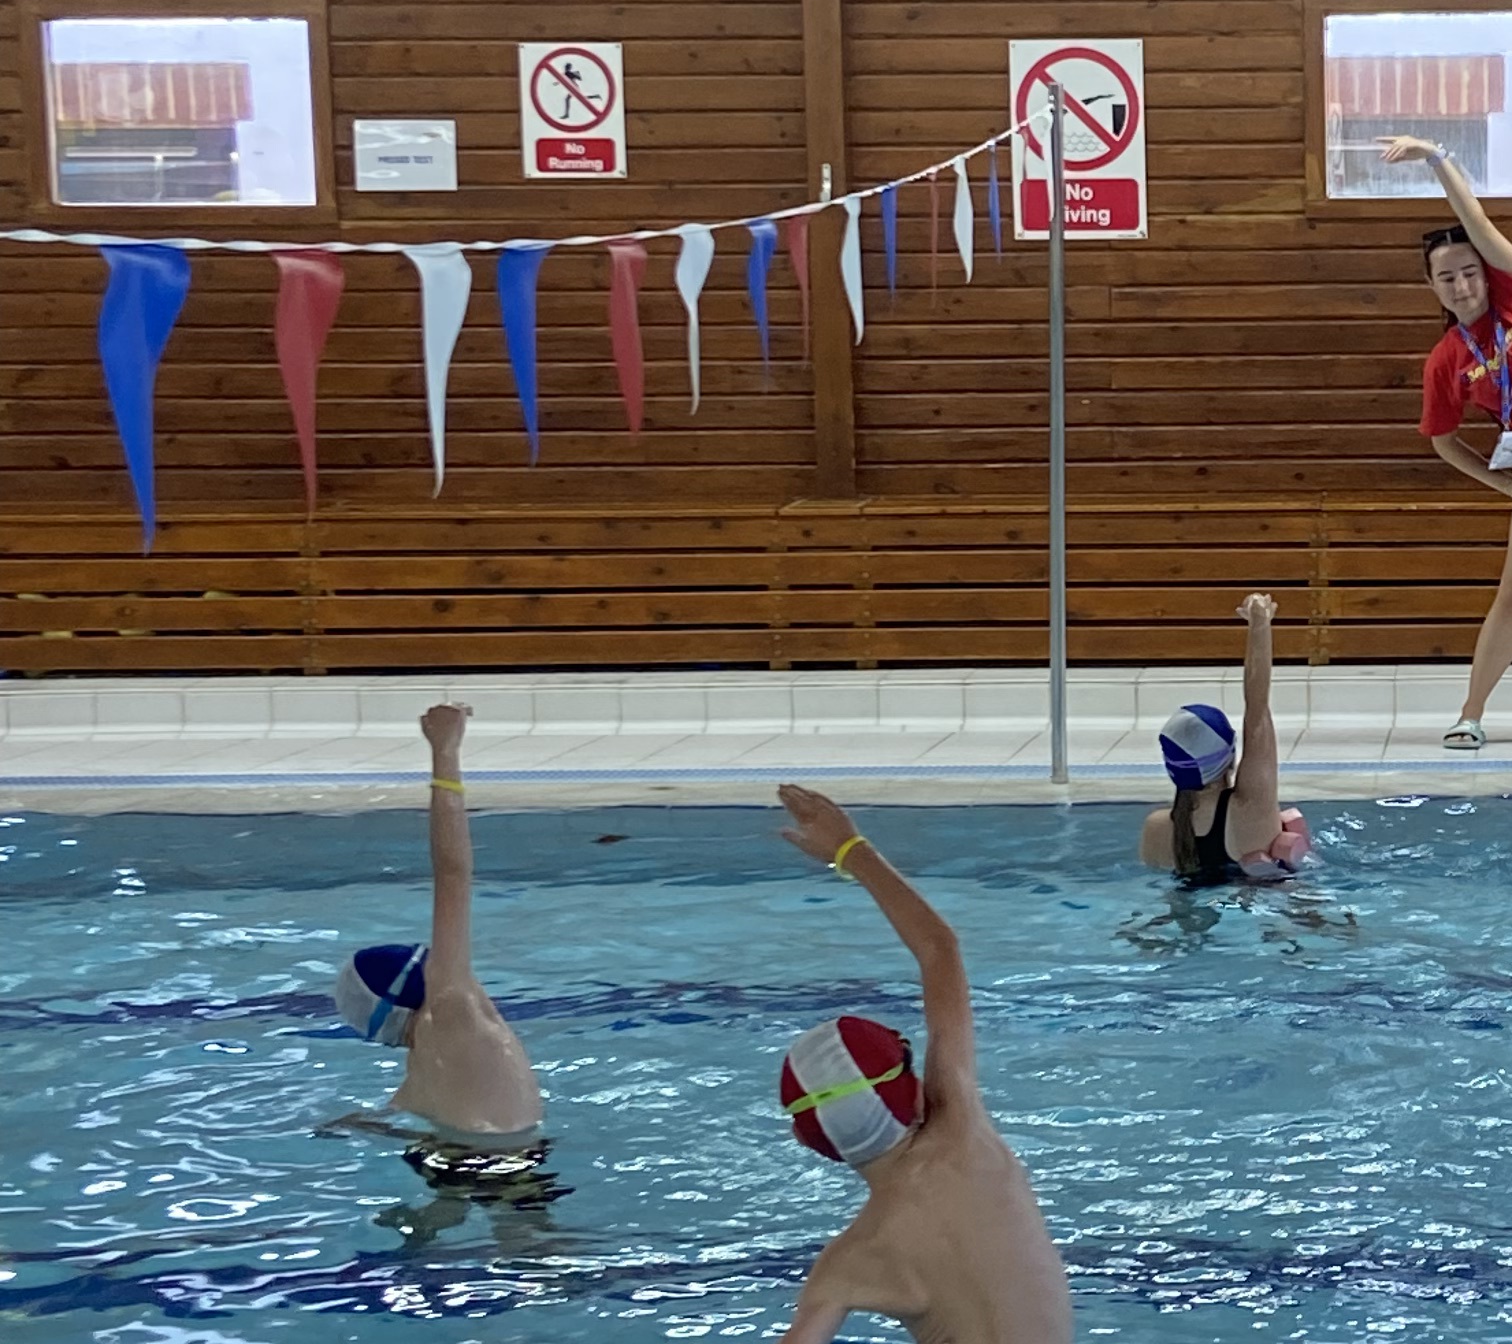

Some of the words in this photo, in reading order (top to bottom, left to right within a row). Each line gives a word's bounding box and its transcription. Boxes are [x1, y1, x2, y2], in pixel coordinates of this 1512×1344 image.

[564, 142, 586, 155] No
[547, 156, 604, 172] Running
[1065, 183, 1094, 201] No
[1063, 205, 1110, 225] iving
